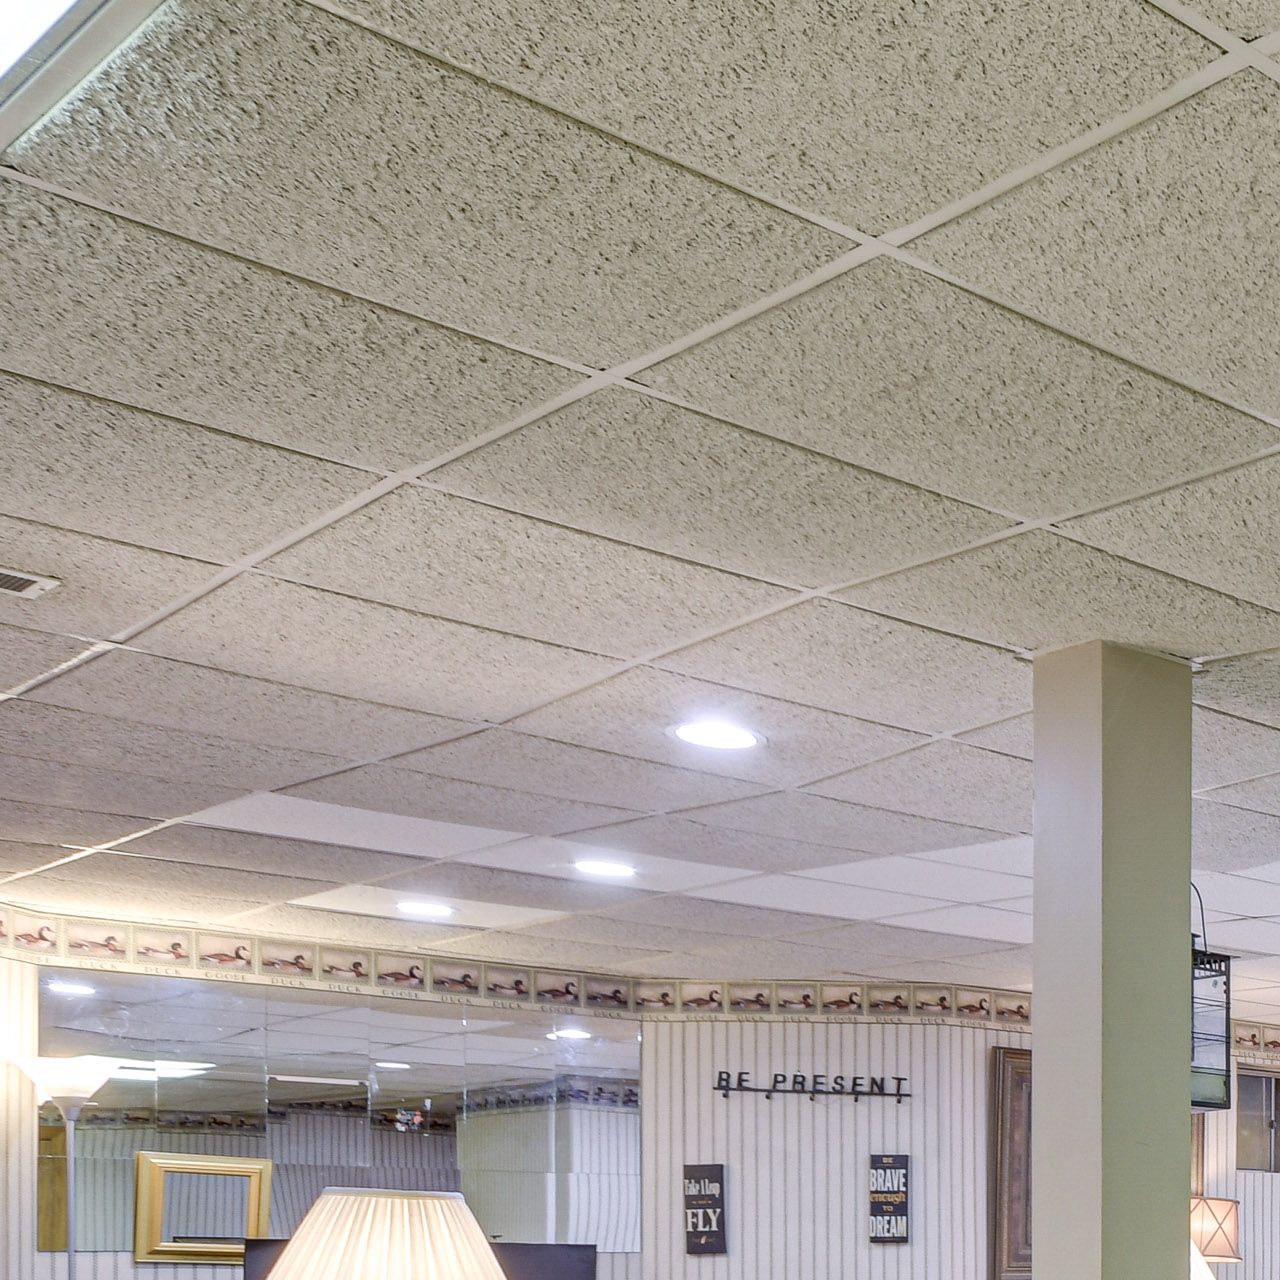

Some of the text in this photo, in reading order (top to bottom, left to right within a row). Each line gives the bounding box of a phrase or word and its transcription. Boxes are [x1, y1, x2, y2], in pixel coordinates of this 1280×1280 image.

[771, 1072, 908, 1095] PRESENT
[870, 1168, 906, 1192] BRAVE
[686, 1208, 721, 1232] FLY
[869, 1215, 907, 1238] DREAM
